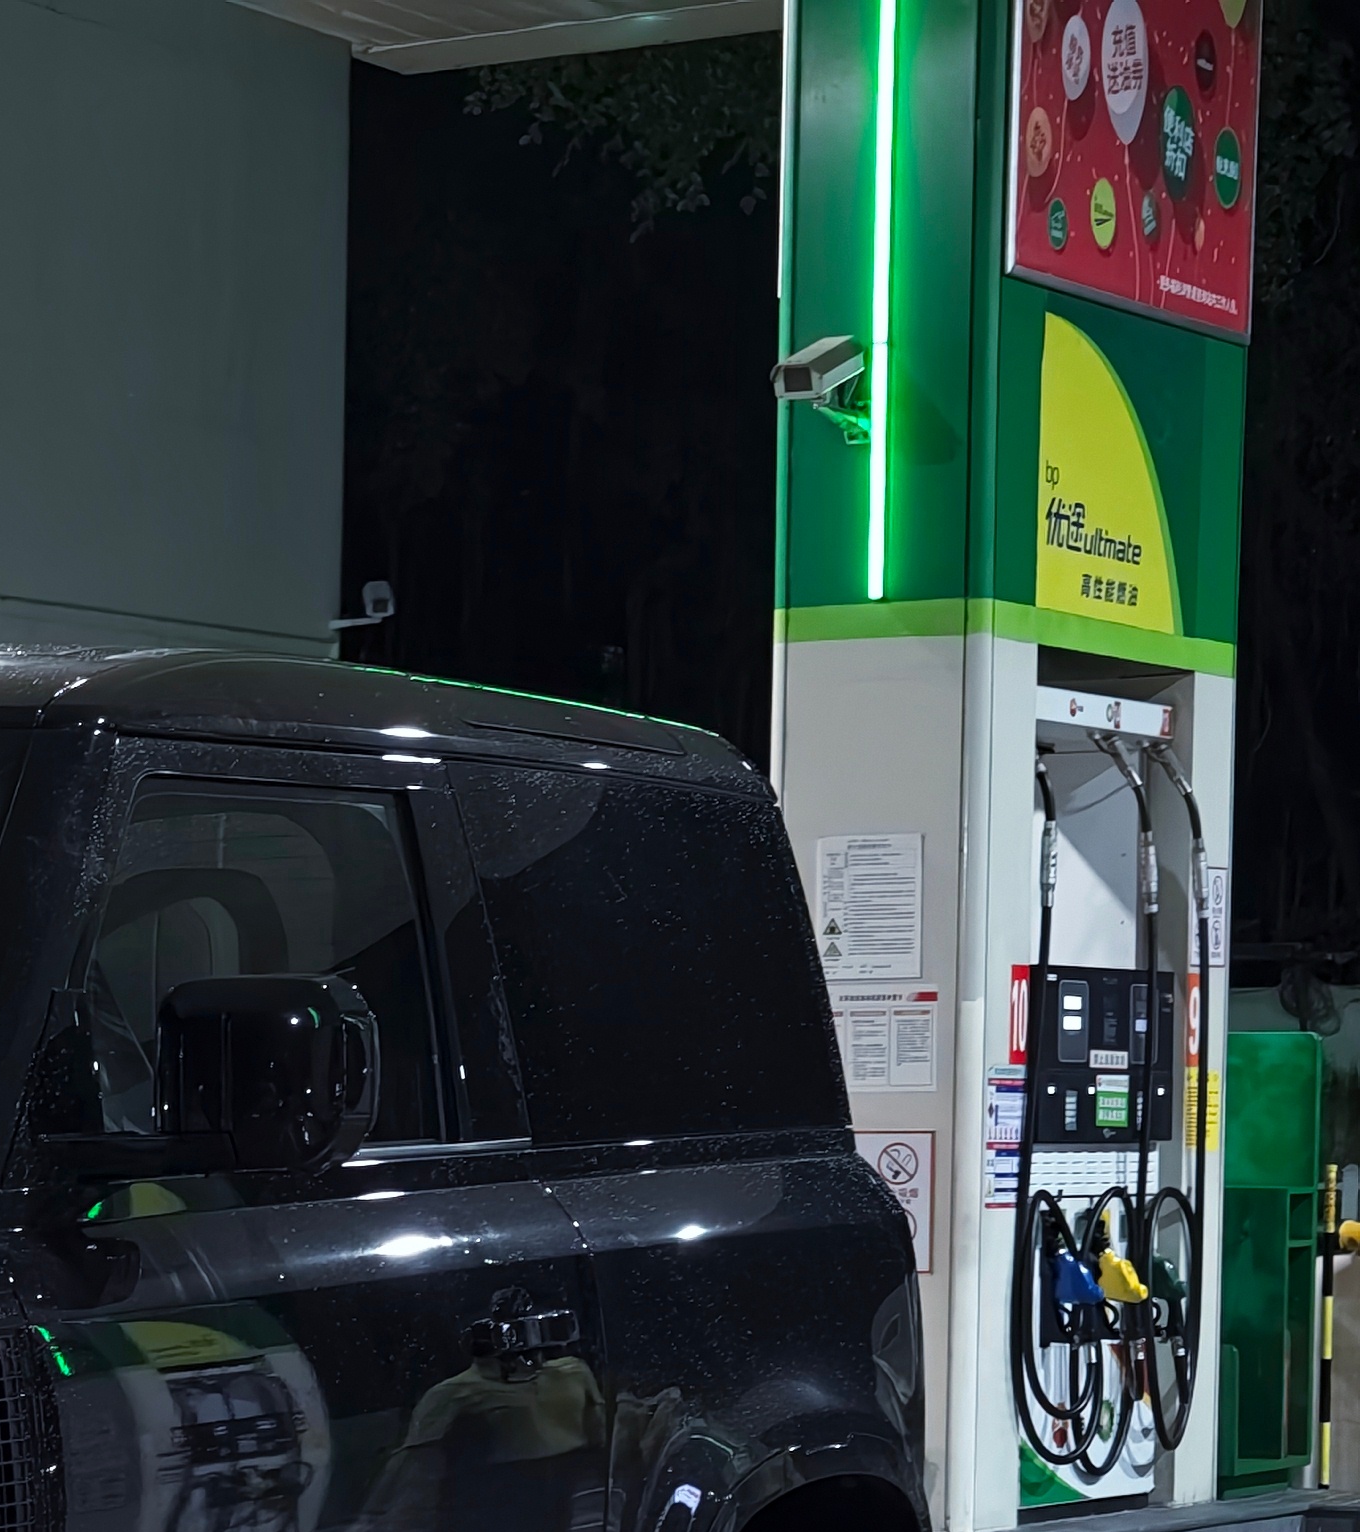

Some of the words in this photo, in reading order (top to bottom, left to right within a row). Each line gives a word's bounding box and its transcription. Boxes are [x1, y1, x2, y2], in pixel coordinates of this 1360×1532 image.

[1111, 24, 1137, 59] 充值
[1045, 460, 1060, 490] bp
[1012, 979, 1028, 1053] 10
[1188, 986, 1200, 1056] 9
